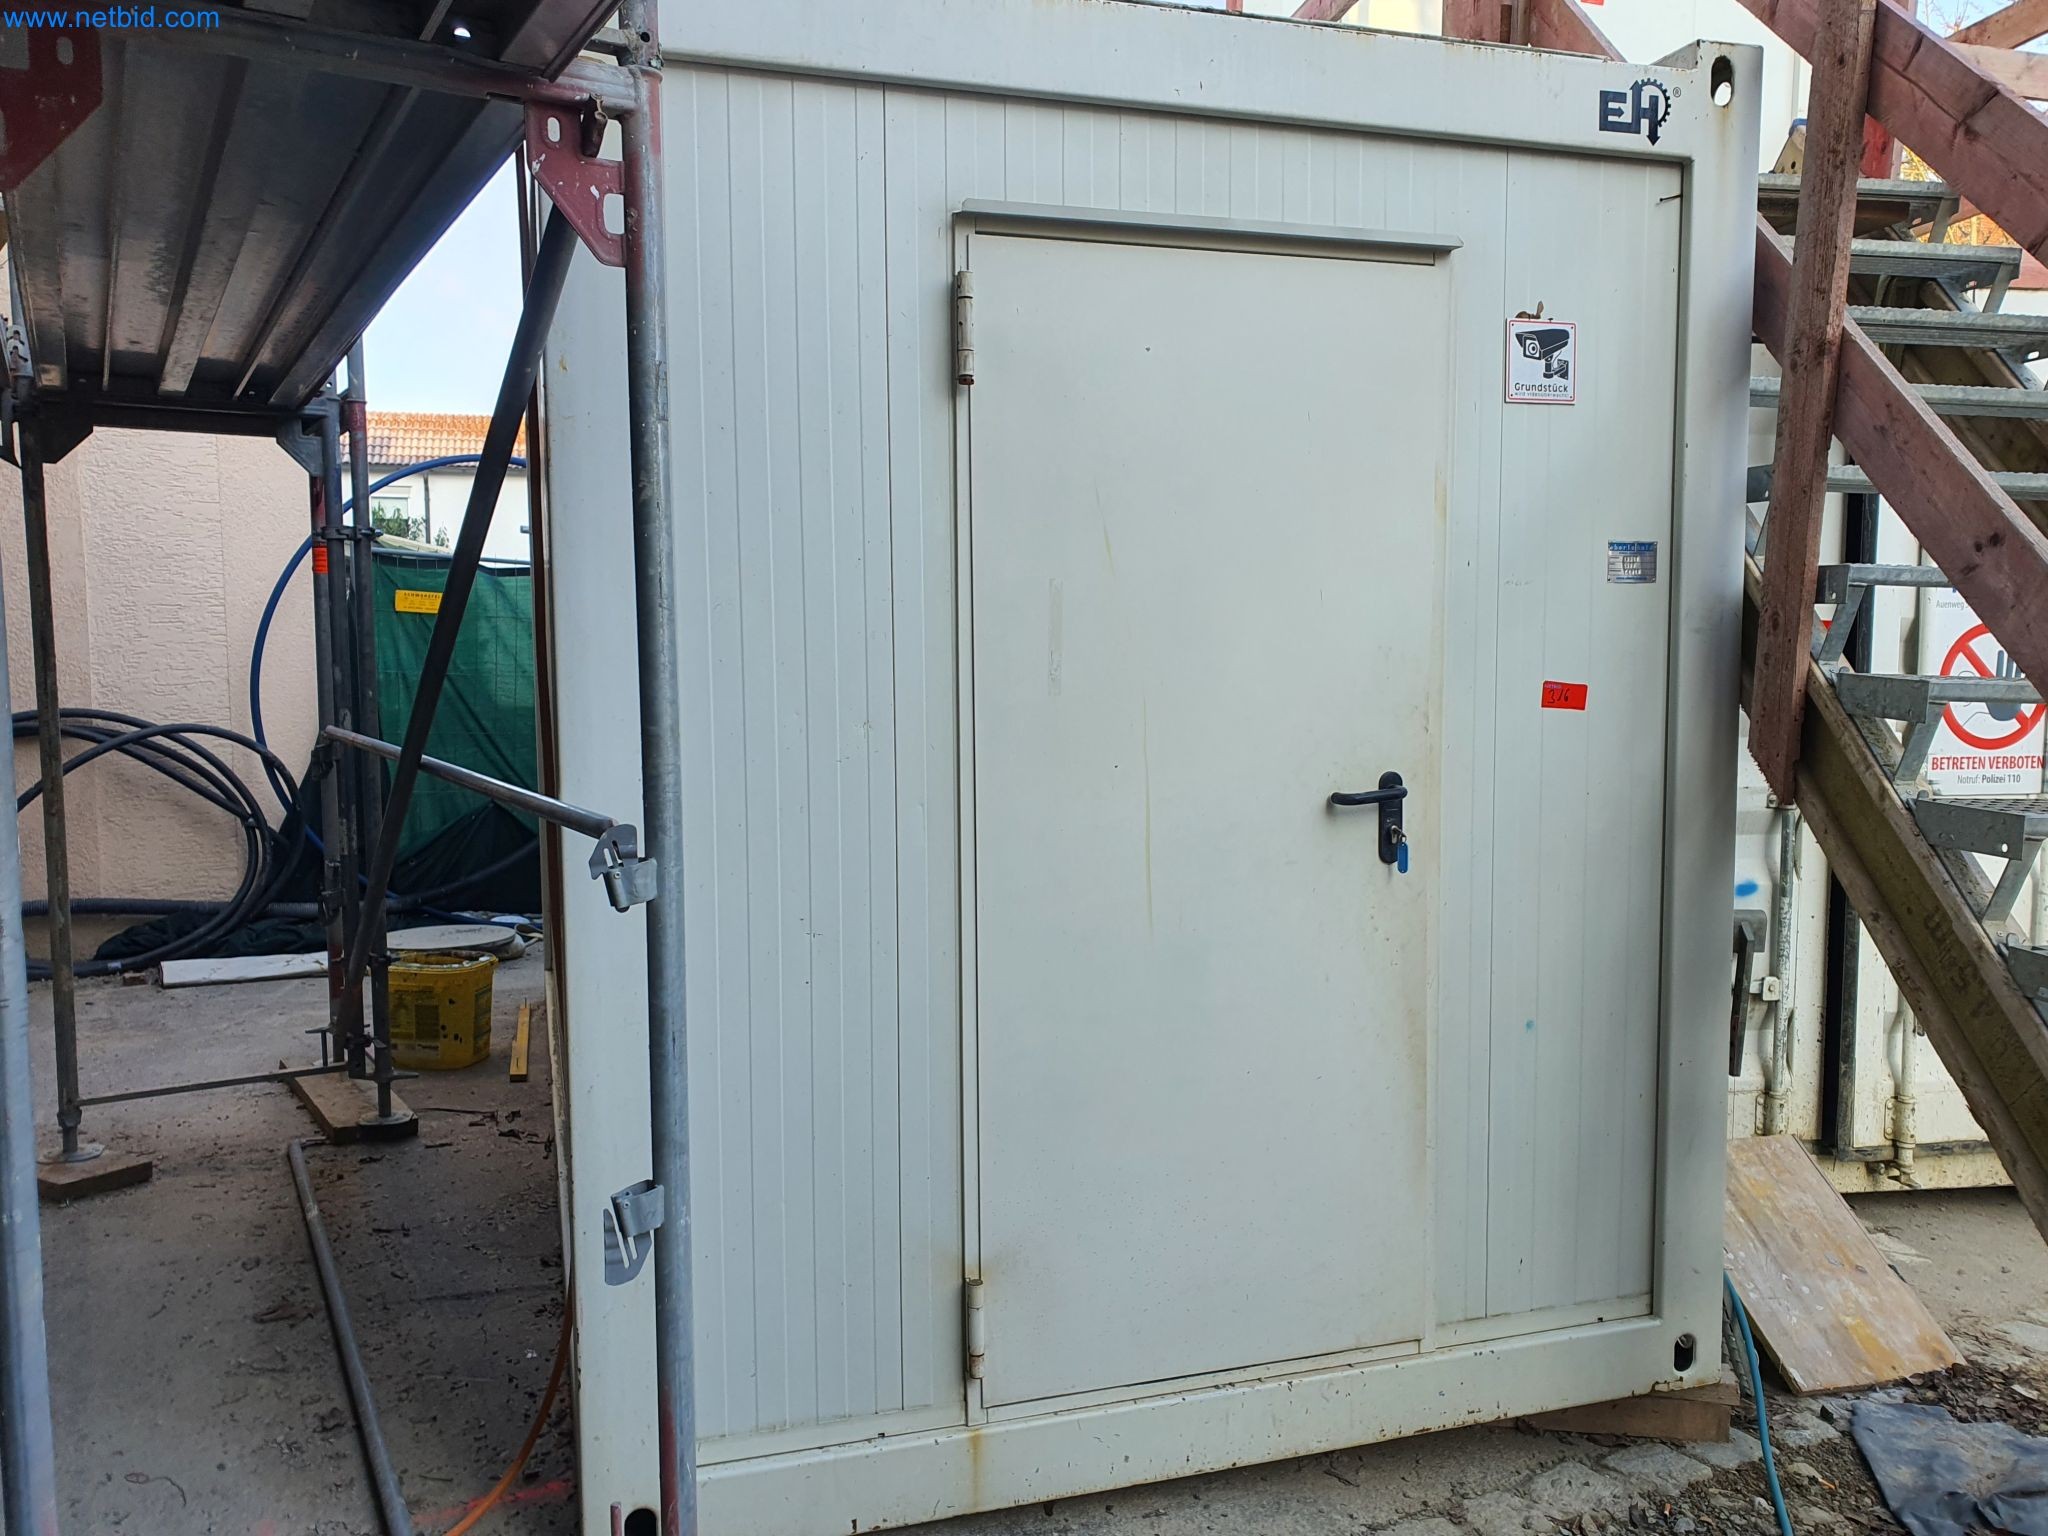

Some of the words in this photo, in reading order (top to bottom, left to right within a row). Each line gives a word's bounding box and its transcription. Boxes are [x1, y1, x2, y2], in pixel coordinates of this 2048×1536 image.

[1514, 382, 1569, 393] Grundstück
[1935, 600, 1965, 611] Auenweg
[1931, 756, 1986, 771] BETRETEN
[1988, 755, 2045, 770] VERBOTEN
[1957, 774, 1981, 784] Notruf:
[1981, 774, 2006, 784] Polizei
[2007, 774, 2021, 783] 110
